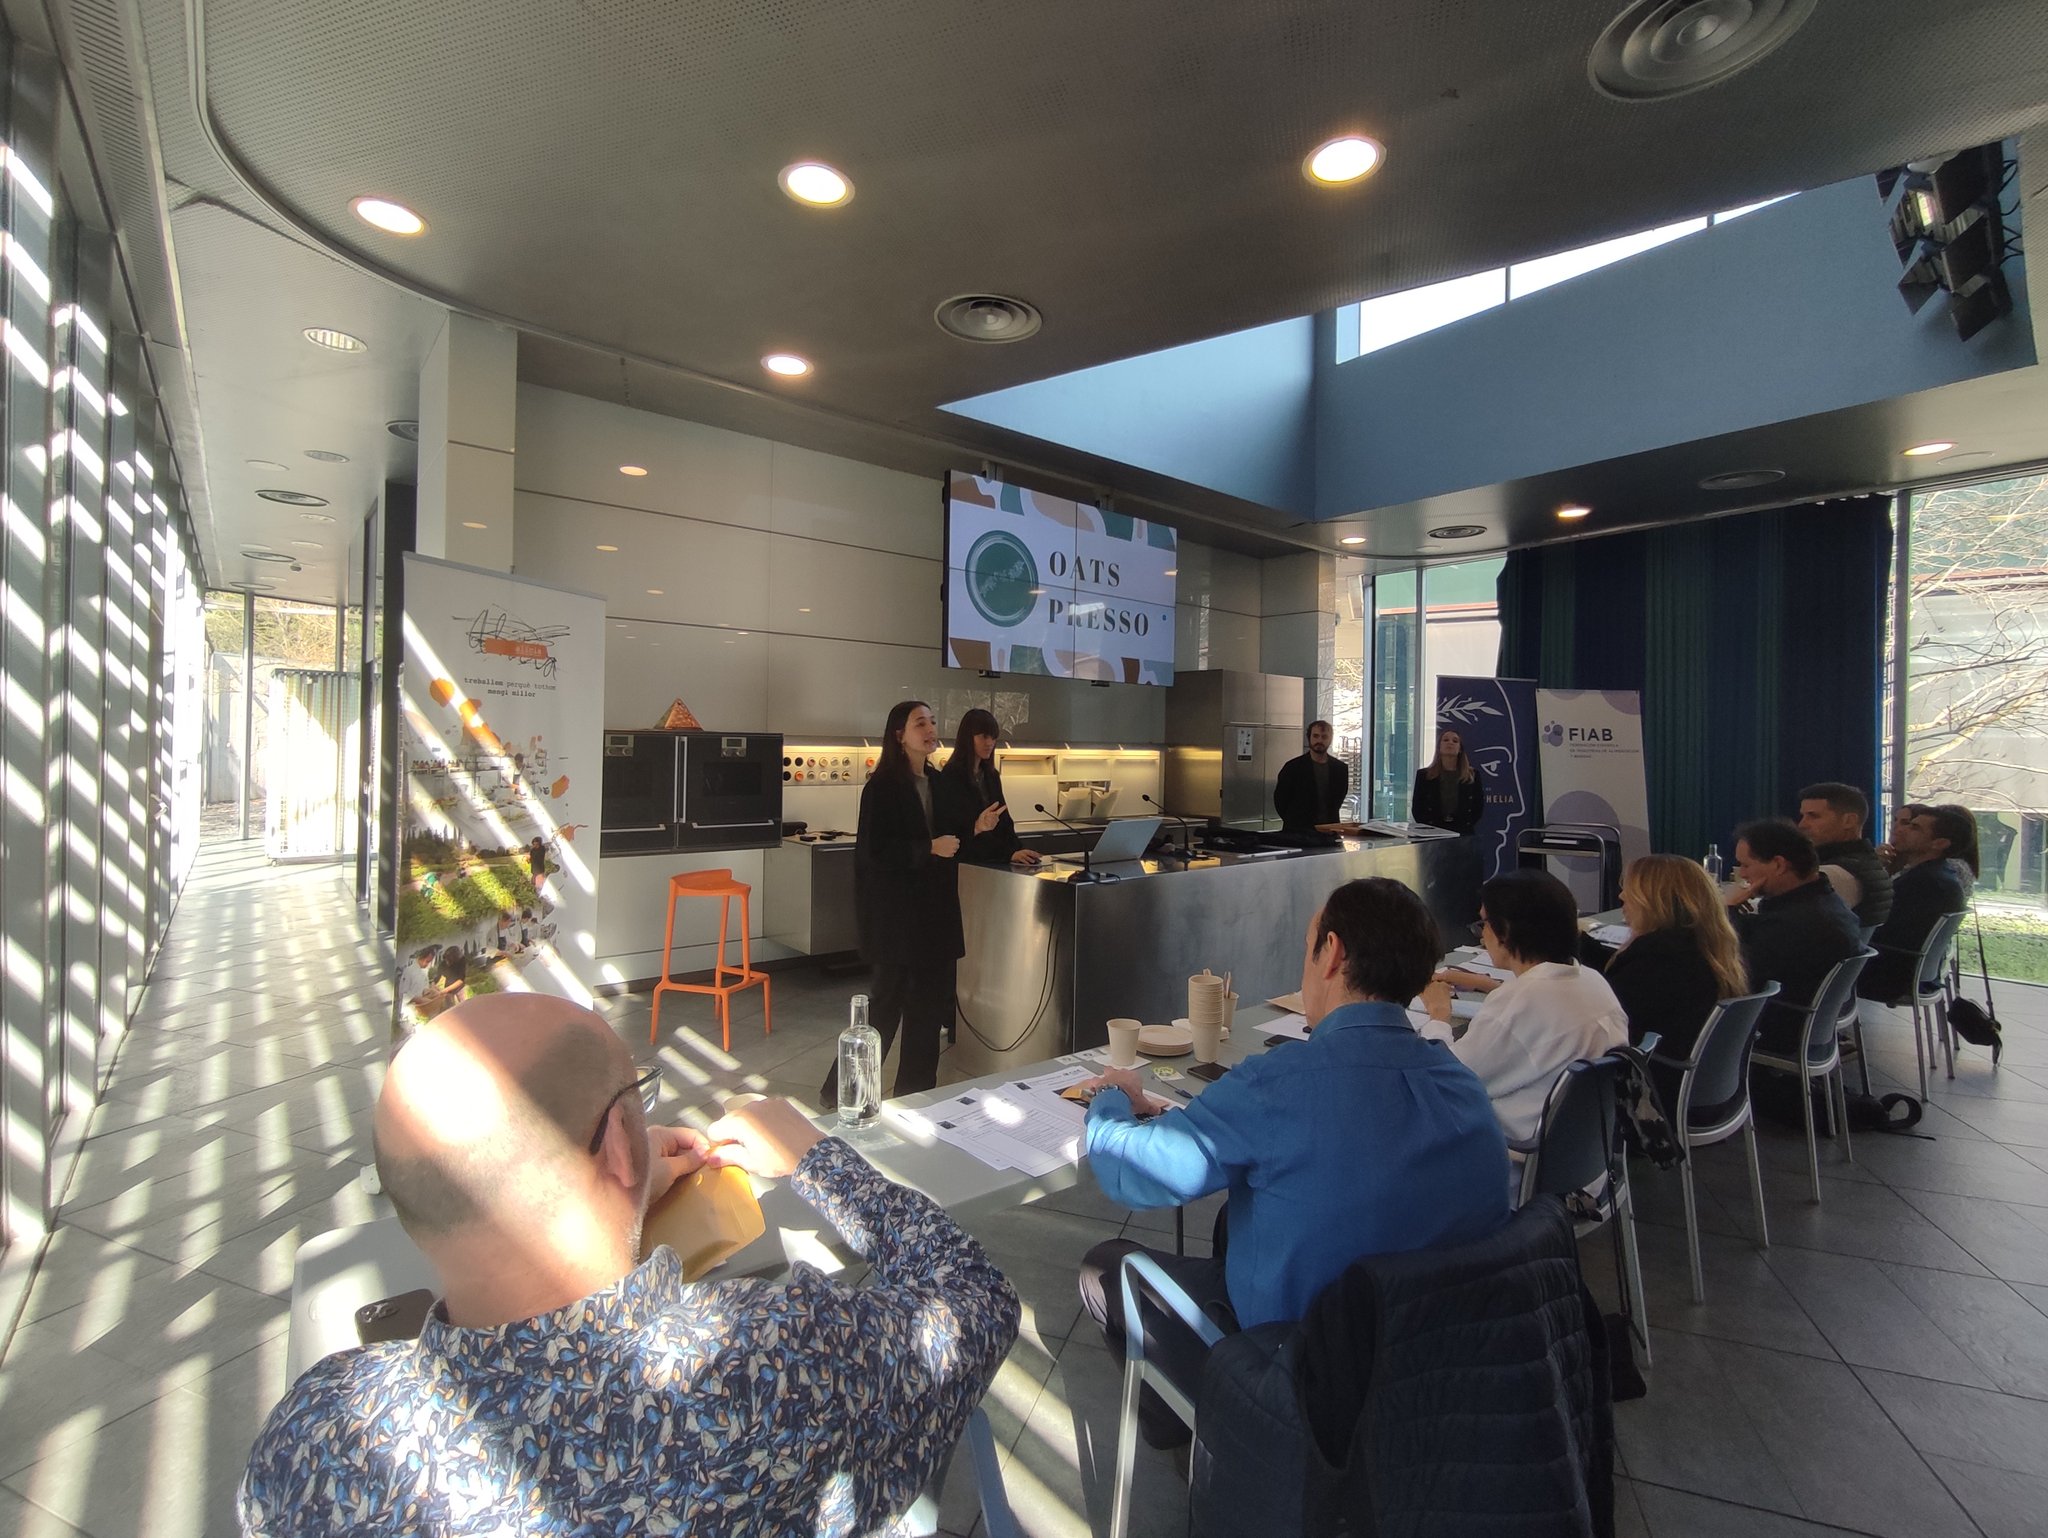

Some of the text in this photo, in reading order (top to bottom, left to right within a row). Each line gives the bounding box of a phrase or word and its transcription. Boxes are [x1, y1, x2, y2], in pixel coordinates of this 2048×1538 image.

[1049, 551, 1120, 587] OATS
[1048, 598, 1149, 637] PRESSO
[464, 677, 504, 686] treballem
[1568, 728, 1613, 741] FIAB
[1485, 794, 1514, 804] HELIA
